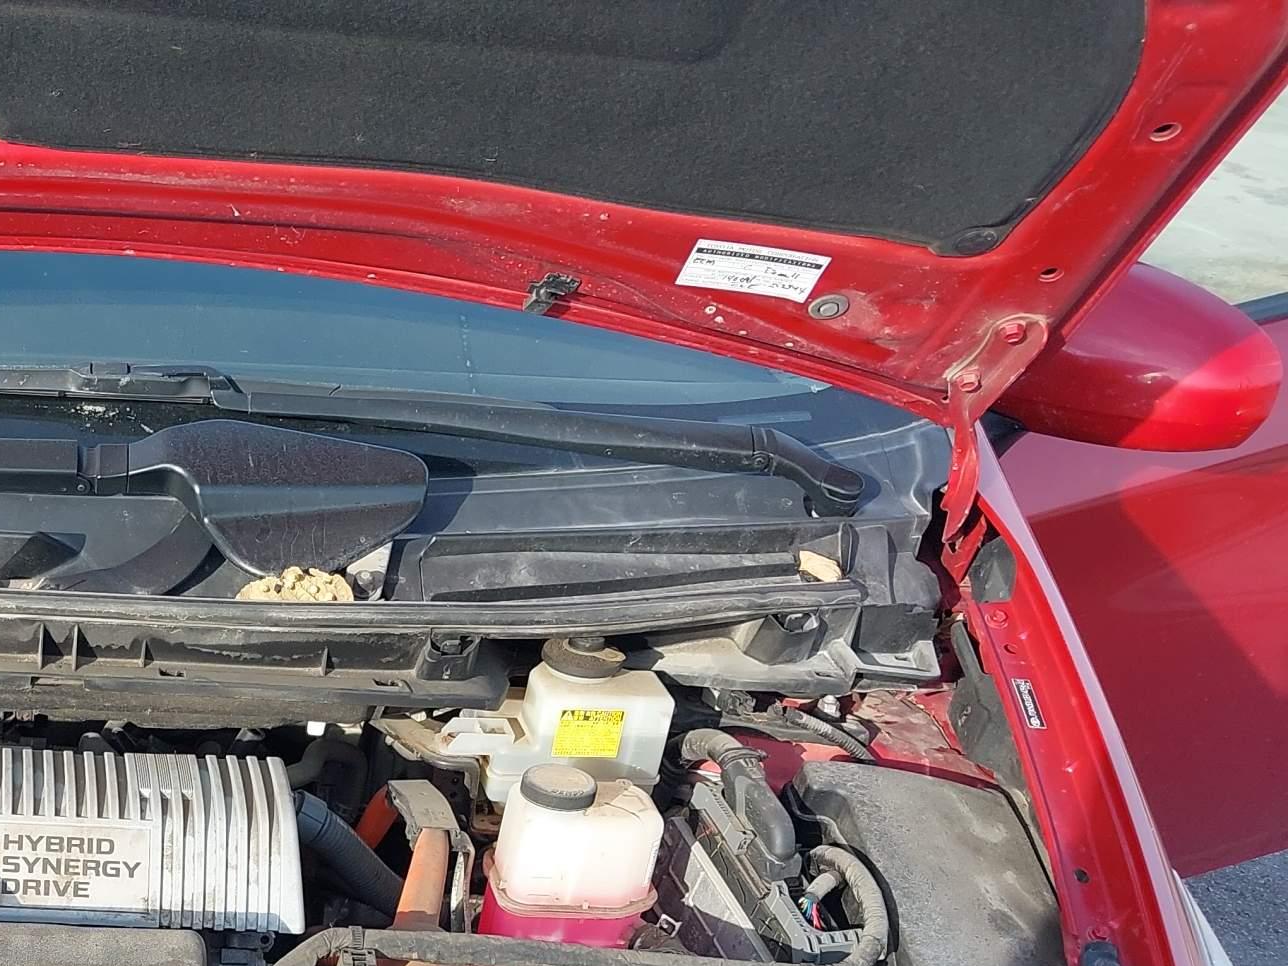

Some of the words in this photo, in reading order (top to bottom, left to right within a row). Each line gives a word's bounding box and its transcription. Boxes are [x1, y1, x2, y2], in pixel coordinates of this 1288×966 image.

[3, 834, 115, 855] HYBRID
[2, 856, 142, 878] SYNERGY
[1, 878, 90, 898] DRIVE
